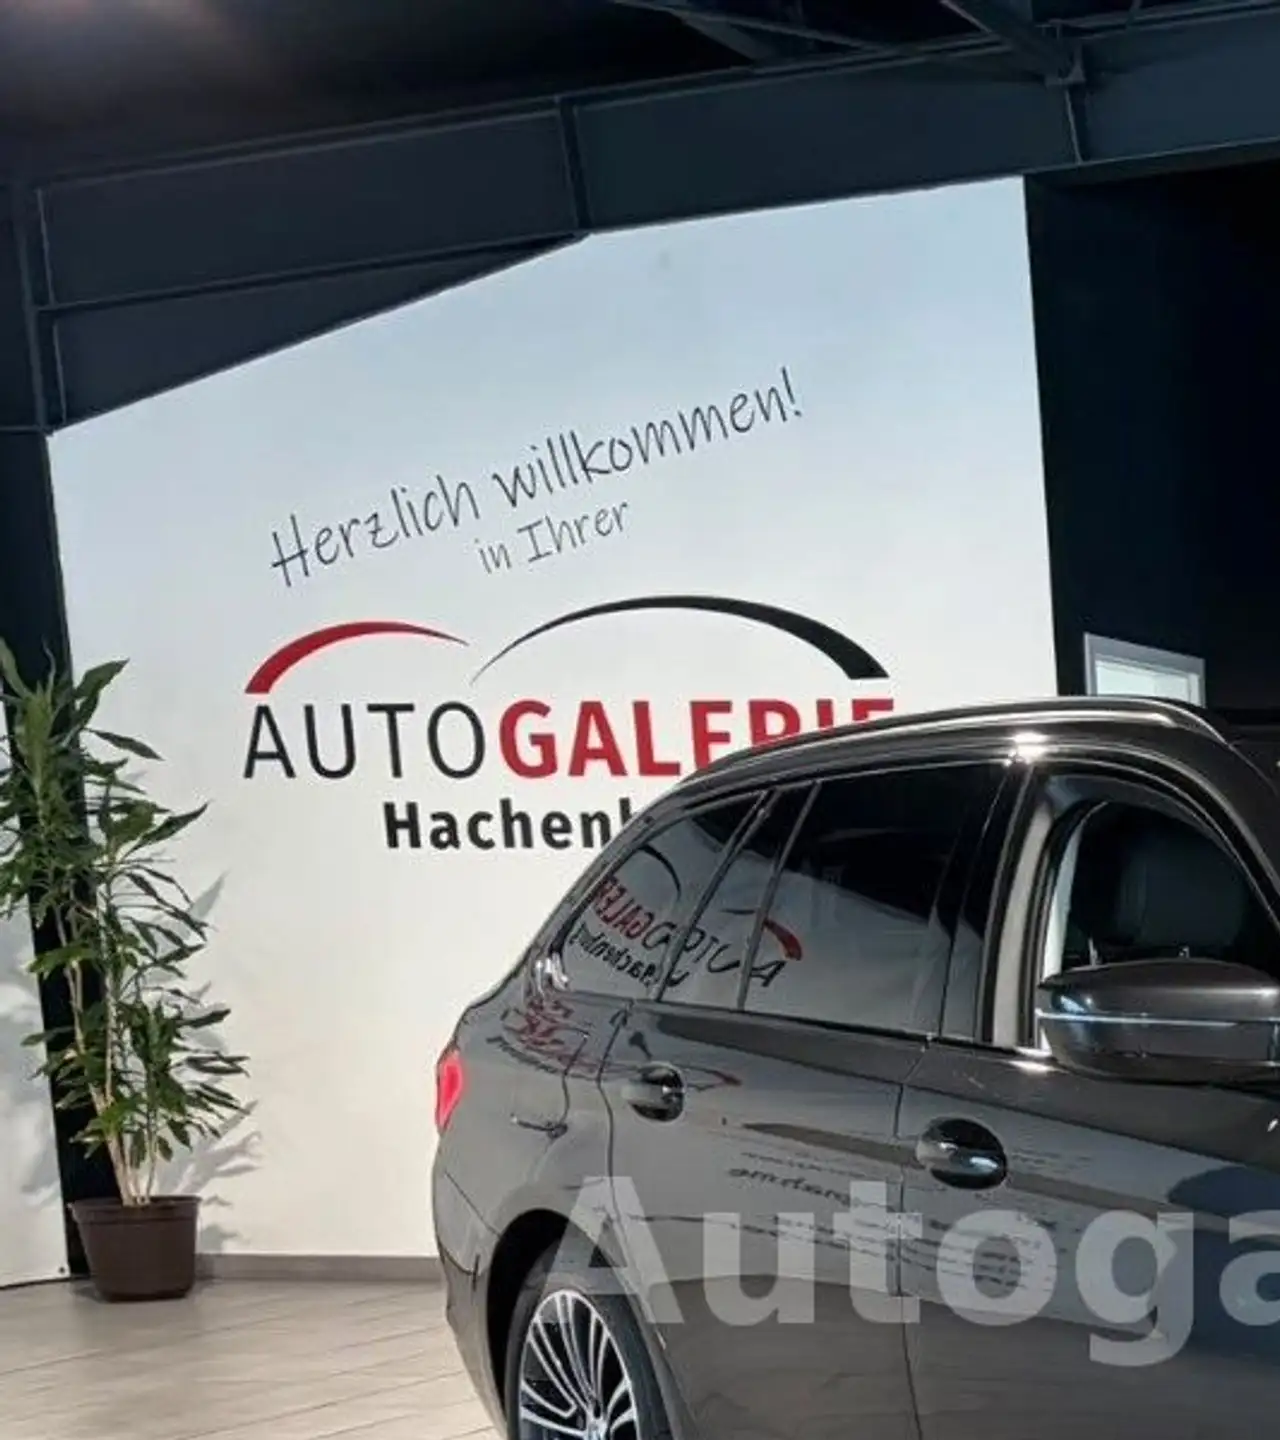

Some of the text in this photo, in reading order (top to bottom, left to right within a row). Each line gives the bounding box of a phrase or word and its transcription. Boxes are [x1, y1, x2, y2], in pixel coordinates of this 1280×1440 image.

[270, 366, 803, 588] Herzlich willkommen!
[479, 500, 630, 575] in Ihrer
[383, 797, 634, 850] Hachen
